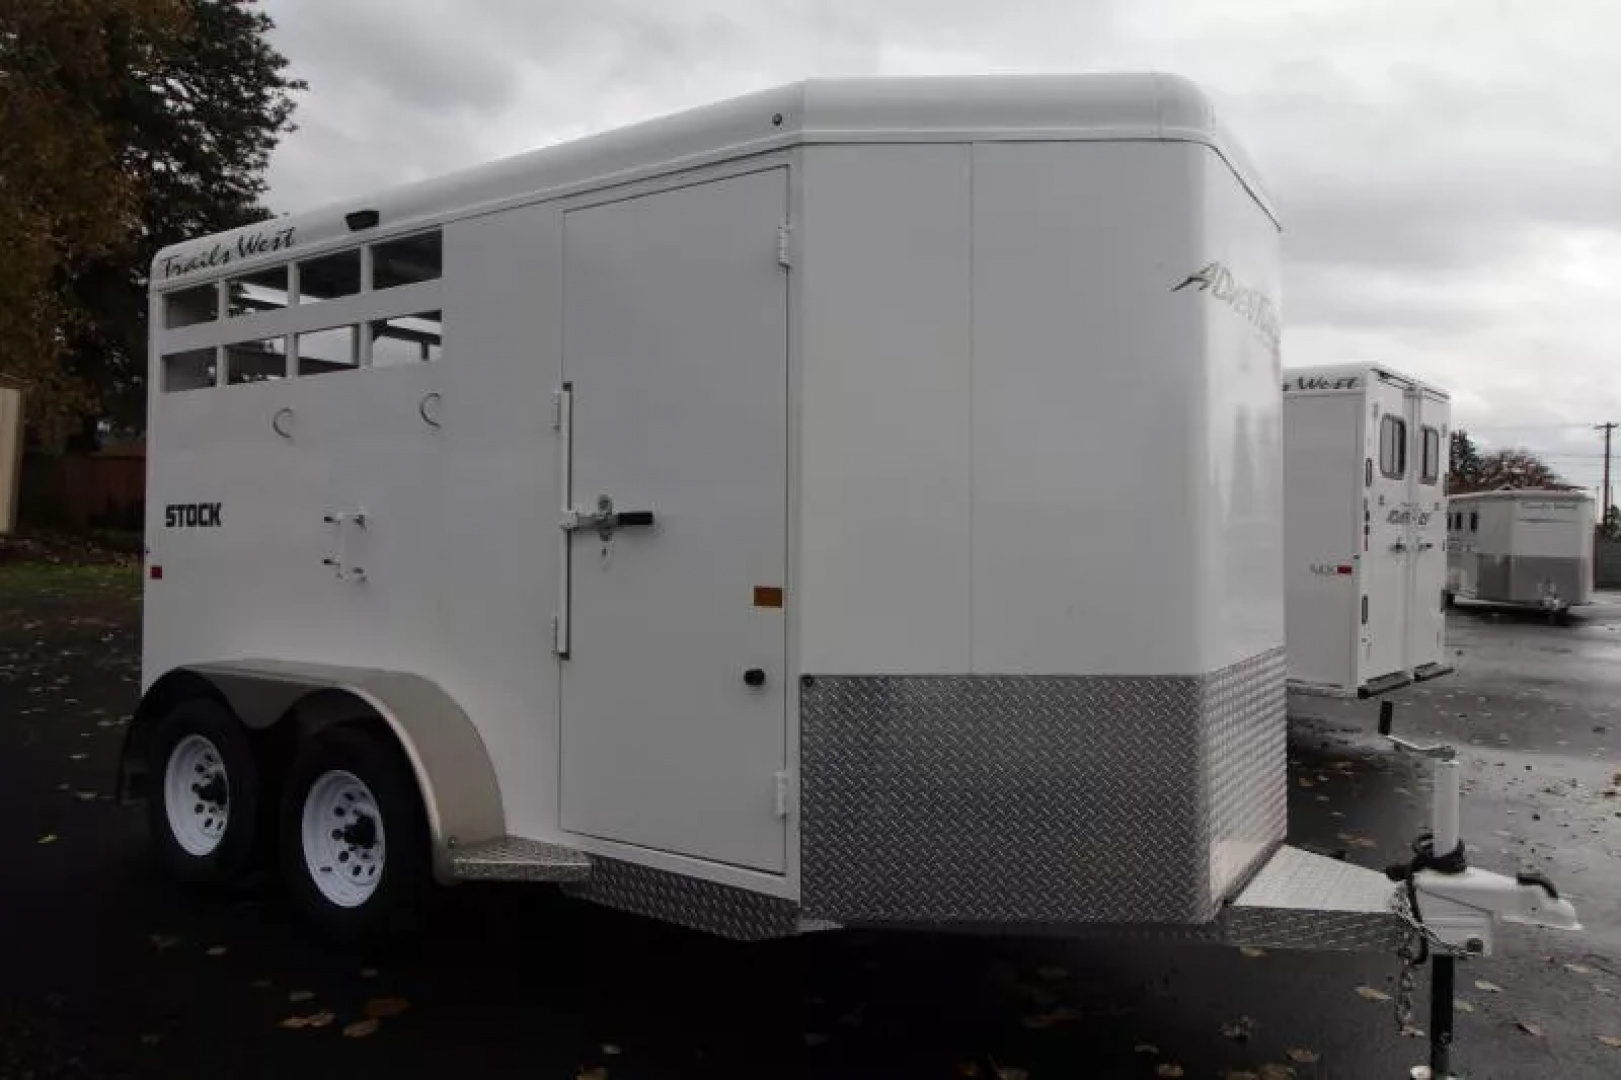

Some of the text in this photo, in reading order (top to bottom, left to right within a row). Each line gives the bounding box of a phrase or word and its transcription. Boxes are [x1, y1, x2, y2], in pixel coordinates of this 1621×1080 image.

[161, 226, 296, 279] Trails West
[1297, 376, 1359, 390] West
[165, 502, 222, 528] STOCK
